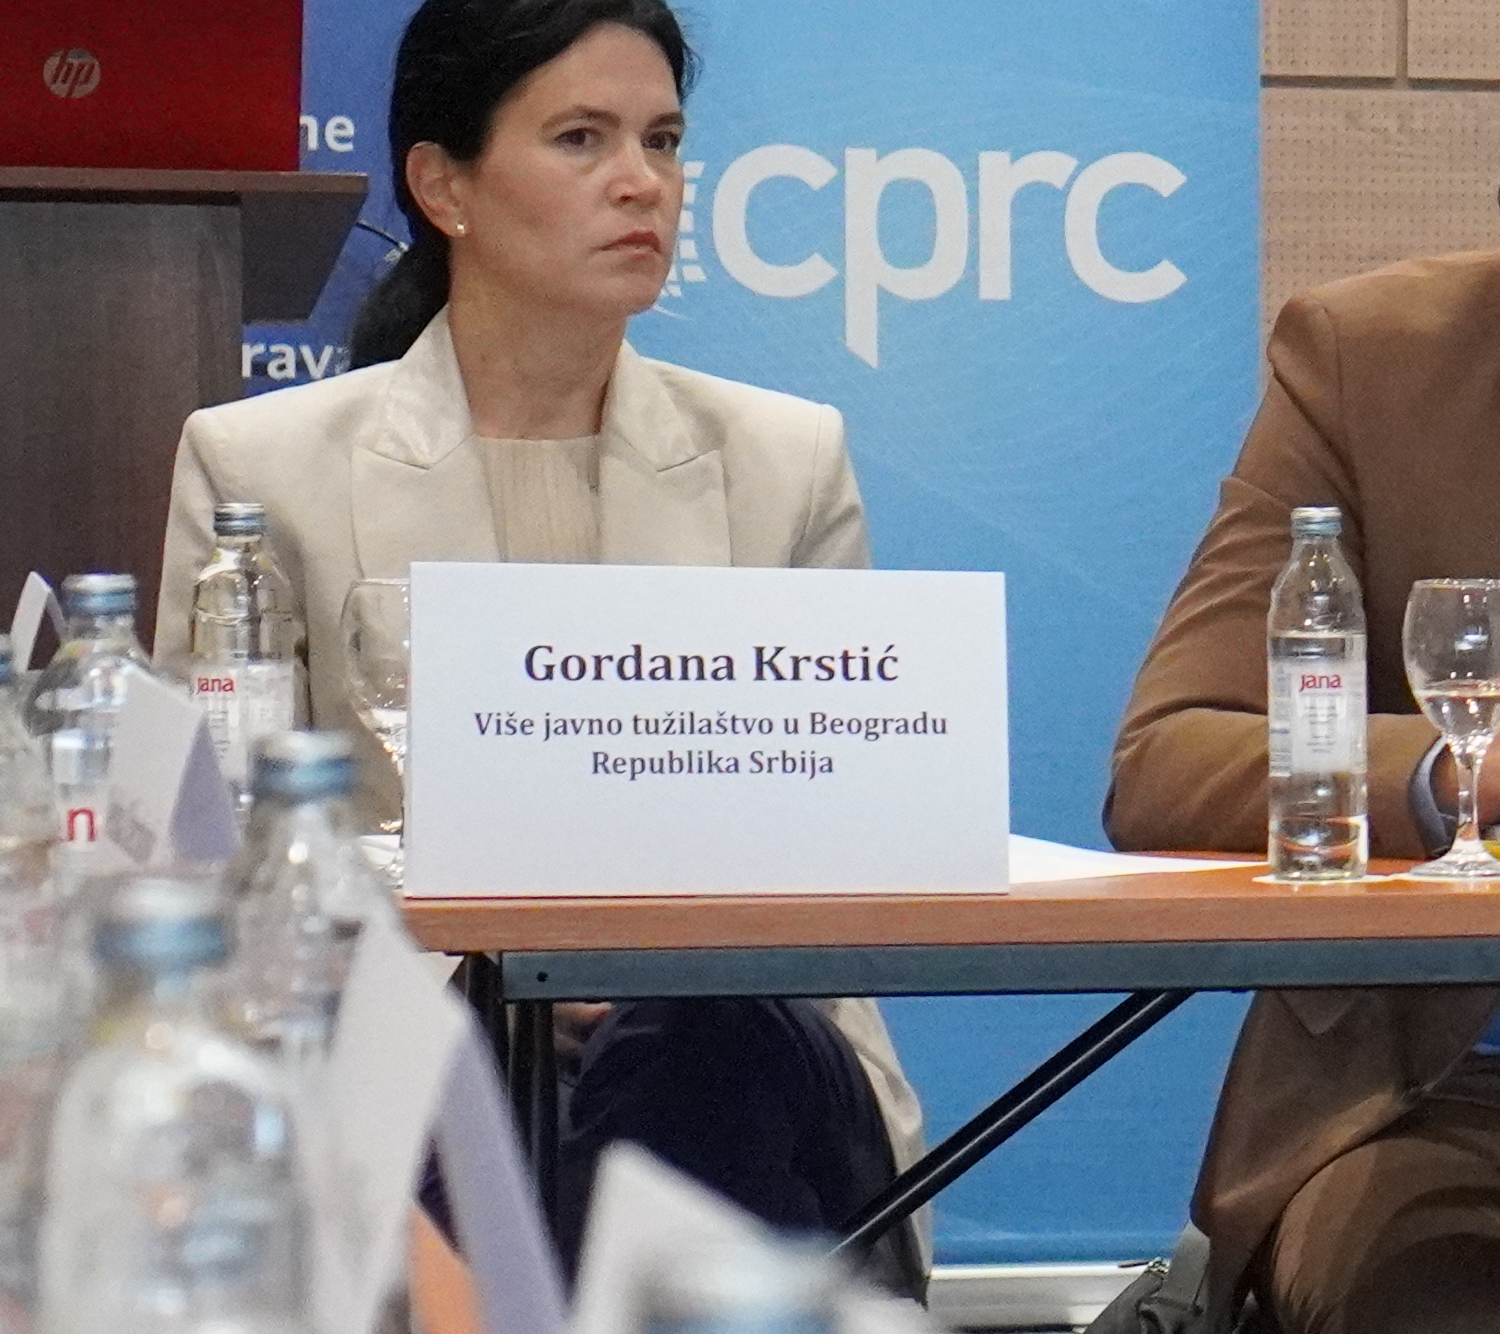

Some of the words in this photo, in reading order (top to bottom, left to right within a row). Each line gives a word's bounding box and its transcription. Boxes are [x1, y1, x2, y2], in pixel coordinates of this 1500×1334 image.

[299, 114, 356, 153] ne
[712, 144, 1188, 368] cprc
[242, 340, 350, 381] rav
[524, 643, 736, 682] Gordana
[753, 644, 898, 682] Krstić
[474, 712, 535, 736] Više
[543, 712, 623, 742] javno
[632, 711, 774, 736] tužilaštvo
[783, 717, 799, 735] u
[810, 711, 947, 742] Beogradu
[592, 749, 740, 782] Republika
[749, 749, 834, 780] Srbija
